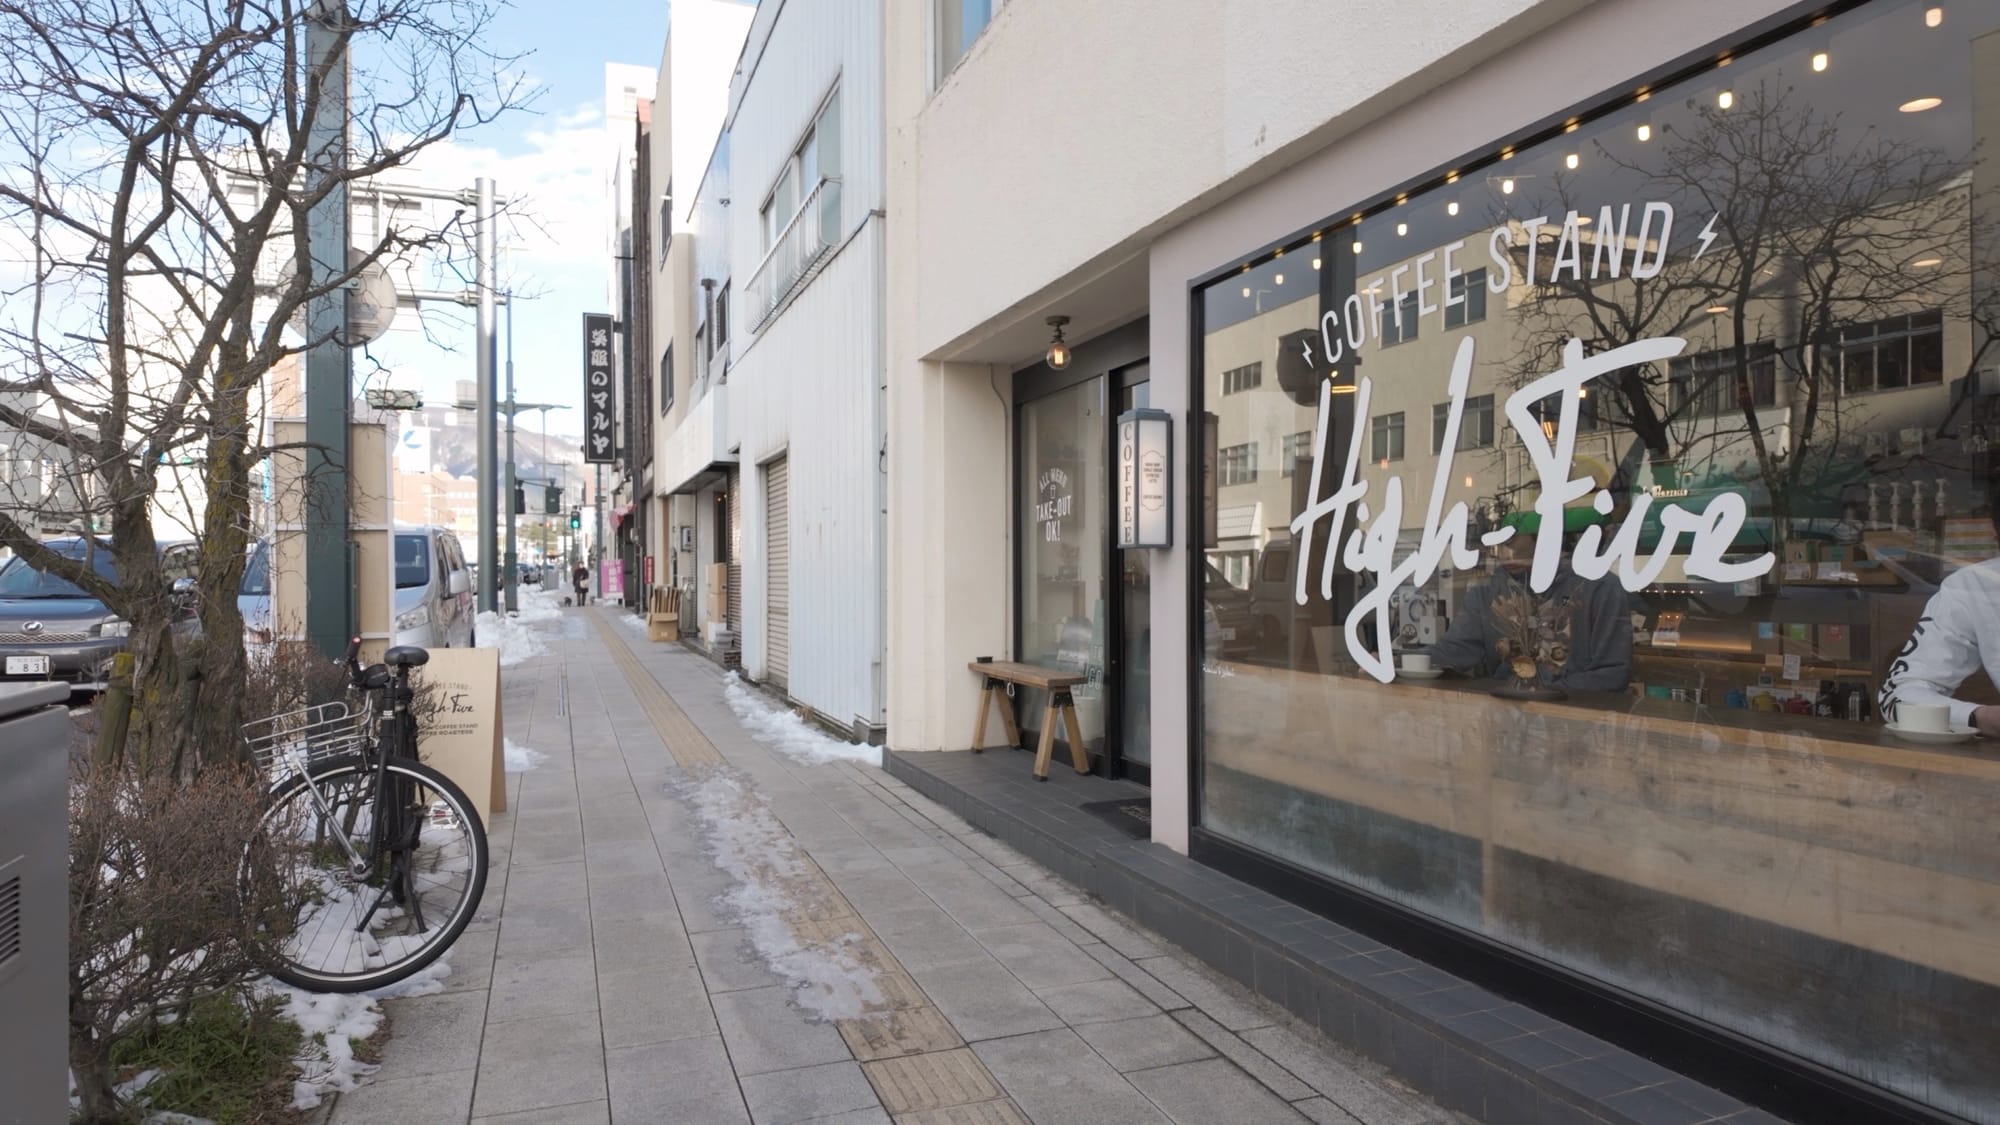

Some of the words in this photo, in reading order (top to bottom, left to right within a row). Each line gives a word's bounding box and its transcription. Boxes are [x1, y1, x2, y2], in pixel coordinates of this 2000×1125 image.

[1321, 240, 1465, 365] COFFEE
[1487, 201, 1674, 294] STAND
[591, 329, 610, 454] 呉服のマルヤ
[1035, 495, 1072, 523] TAKE-OUT
[1046, 520, 1060, 542] OK!
[1123, 423, 1133, 543] COFFEE
[1290, 335, 1776, 684] High-Five
